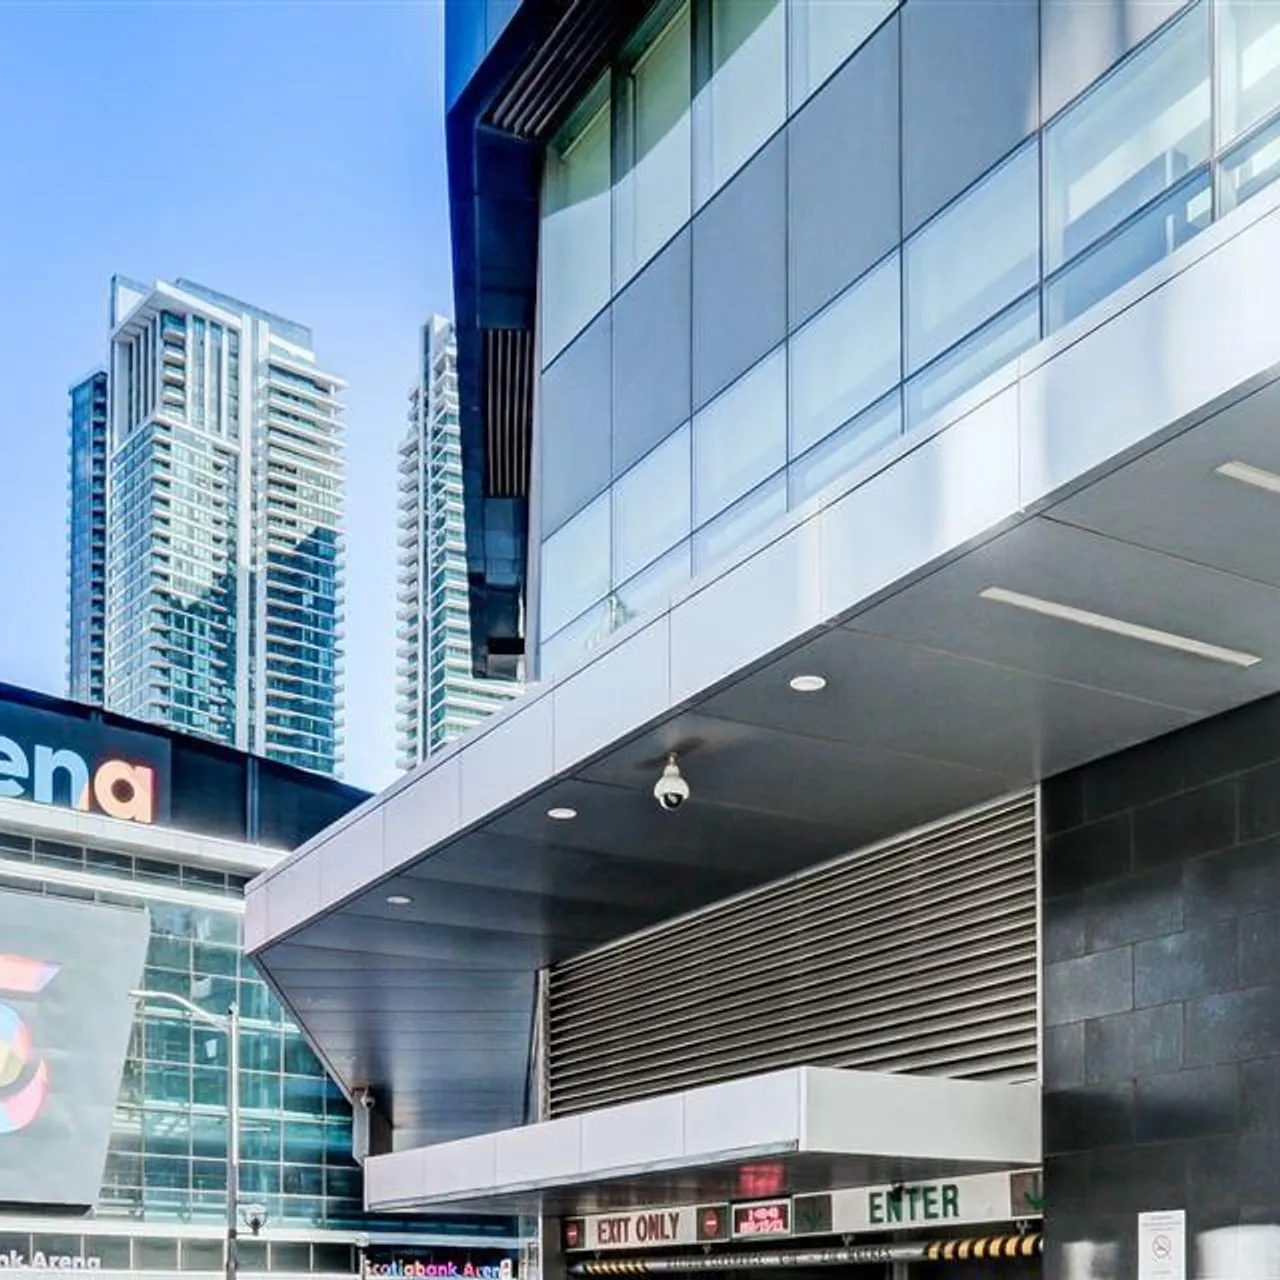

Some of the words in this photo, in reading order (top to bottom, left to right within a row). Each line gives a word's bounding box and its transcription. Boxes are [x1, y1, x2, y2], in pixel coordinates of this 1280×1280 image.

[869, 1183, 959, 1225] ENTER
[597, 1217, 632, 1244] EXIT
[636, 1212, 680, 1241] ONLY
[32, 1251, 101, 1270] Arena
[463, 1261, 512, 1278] Aren
